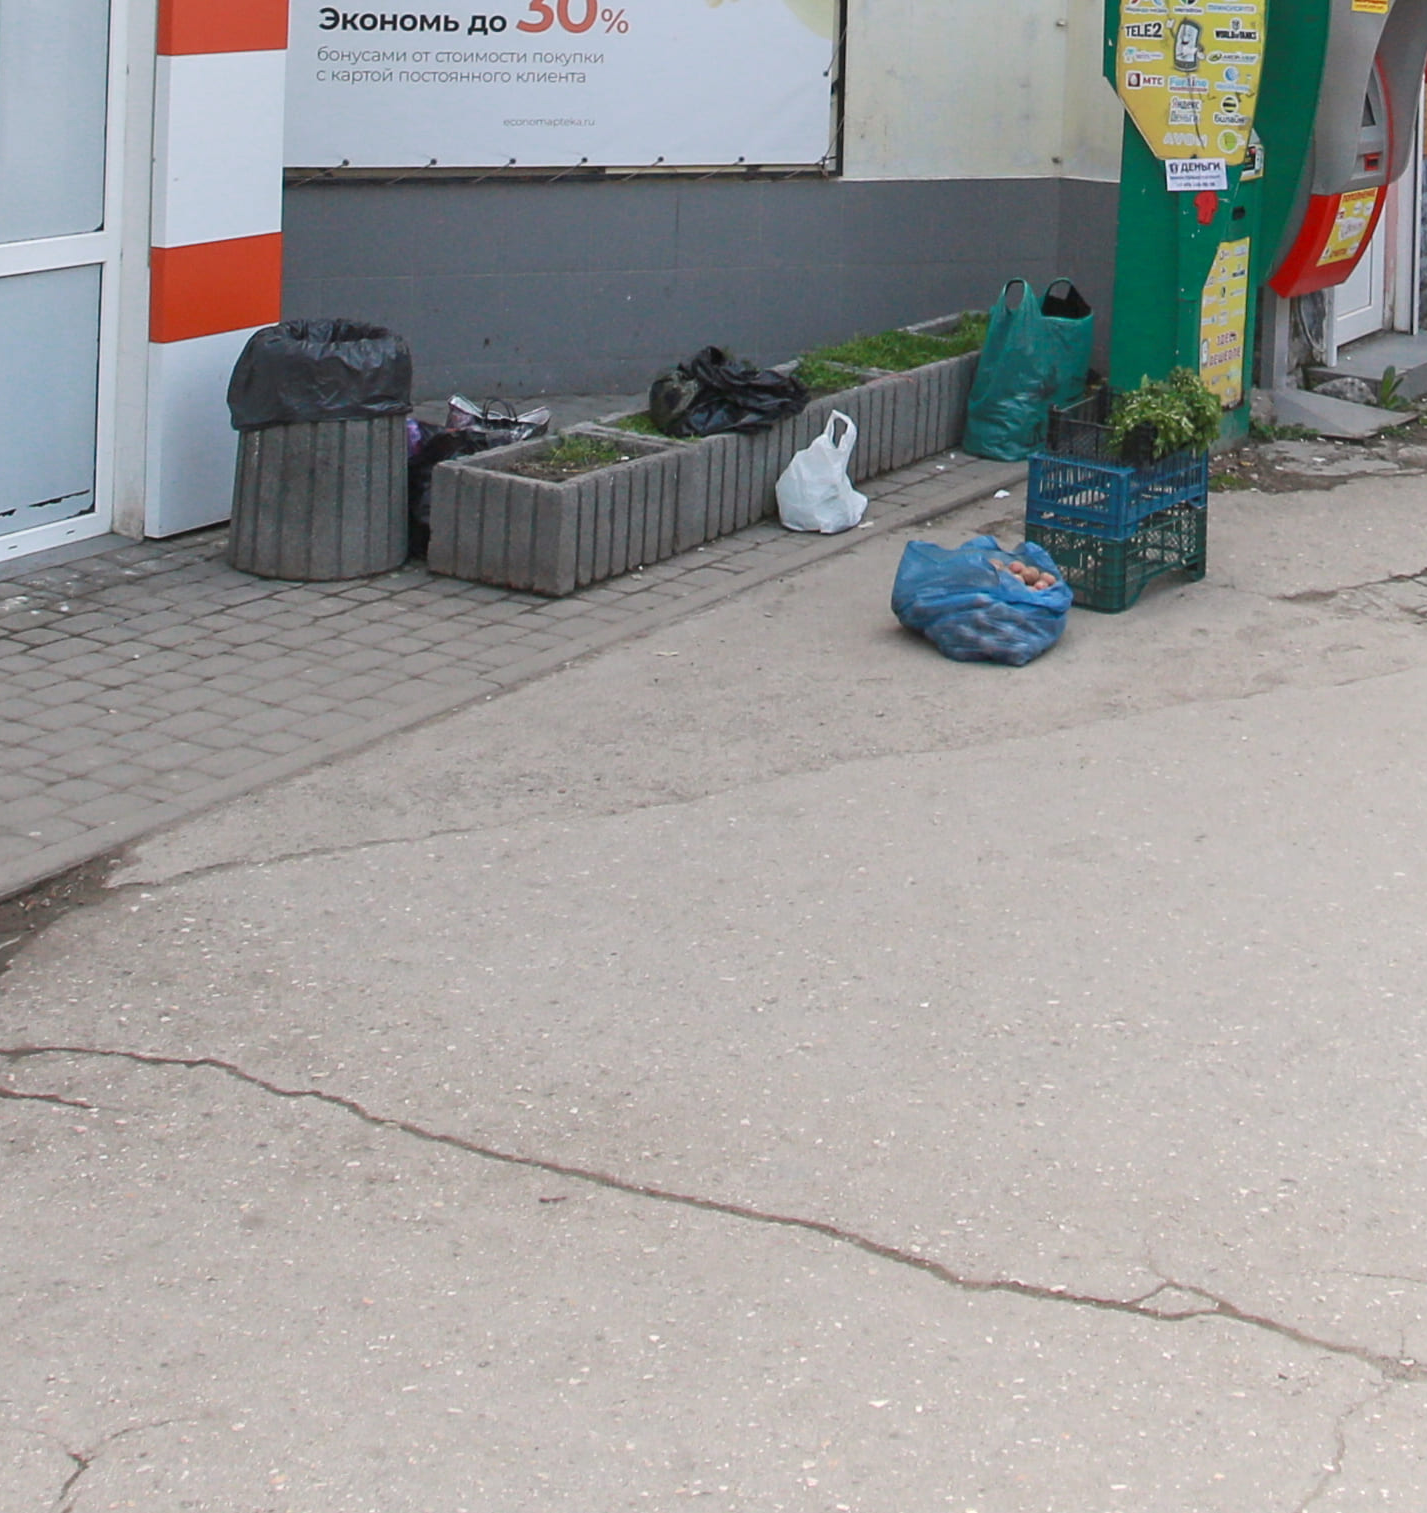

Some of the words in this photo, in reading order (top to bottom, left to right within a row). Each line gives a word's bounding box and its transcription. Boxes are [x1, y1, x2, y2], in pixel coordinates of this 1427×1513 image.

[318, 6, 460, 33] Экономь
[467, 13, 508, 36] до
[1125, 22, 1162, 38] TELE2
[317, 45, 407, 66] бонусами
[411, 50, 432, 63] от
[435, 50, 527, 64] стоимости
[532, 51, 605, 68] покупки
[316, 70, 326, 82] с
[331, 67, 393, 86] картой
[399, 70, 511, 84] постоянного
[516, 70, 587, 84] клиента
[1142, 76, 1163, 86] МТС
[502, 116, 596, 129] economapteka.ru
